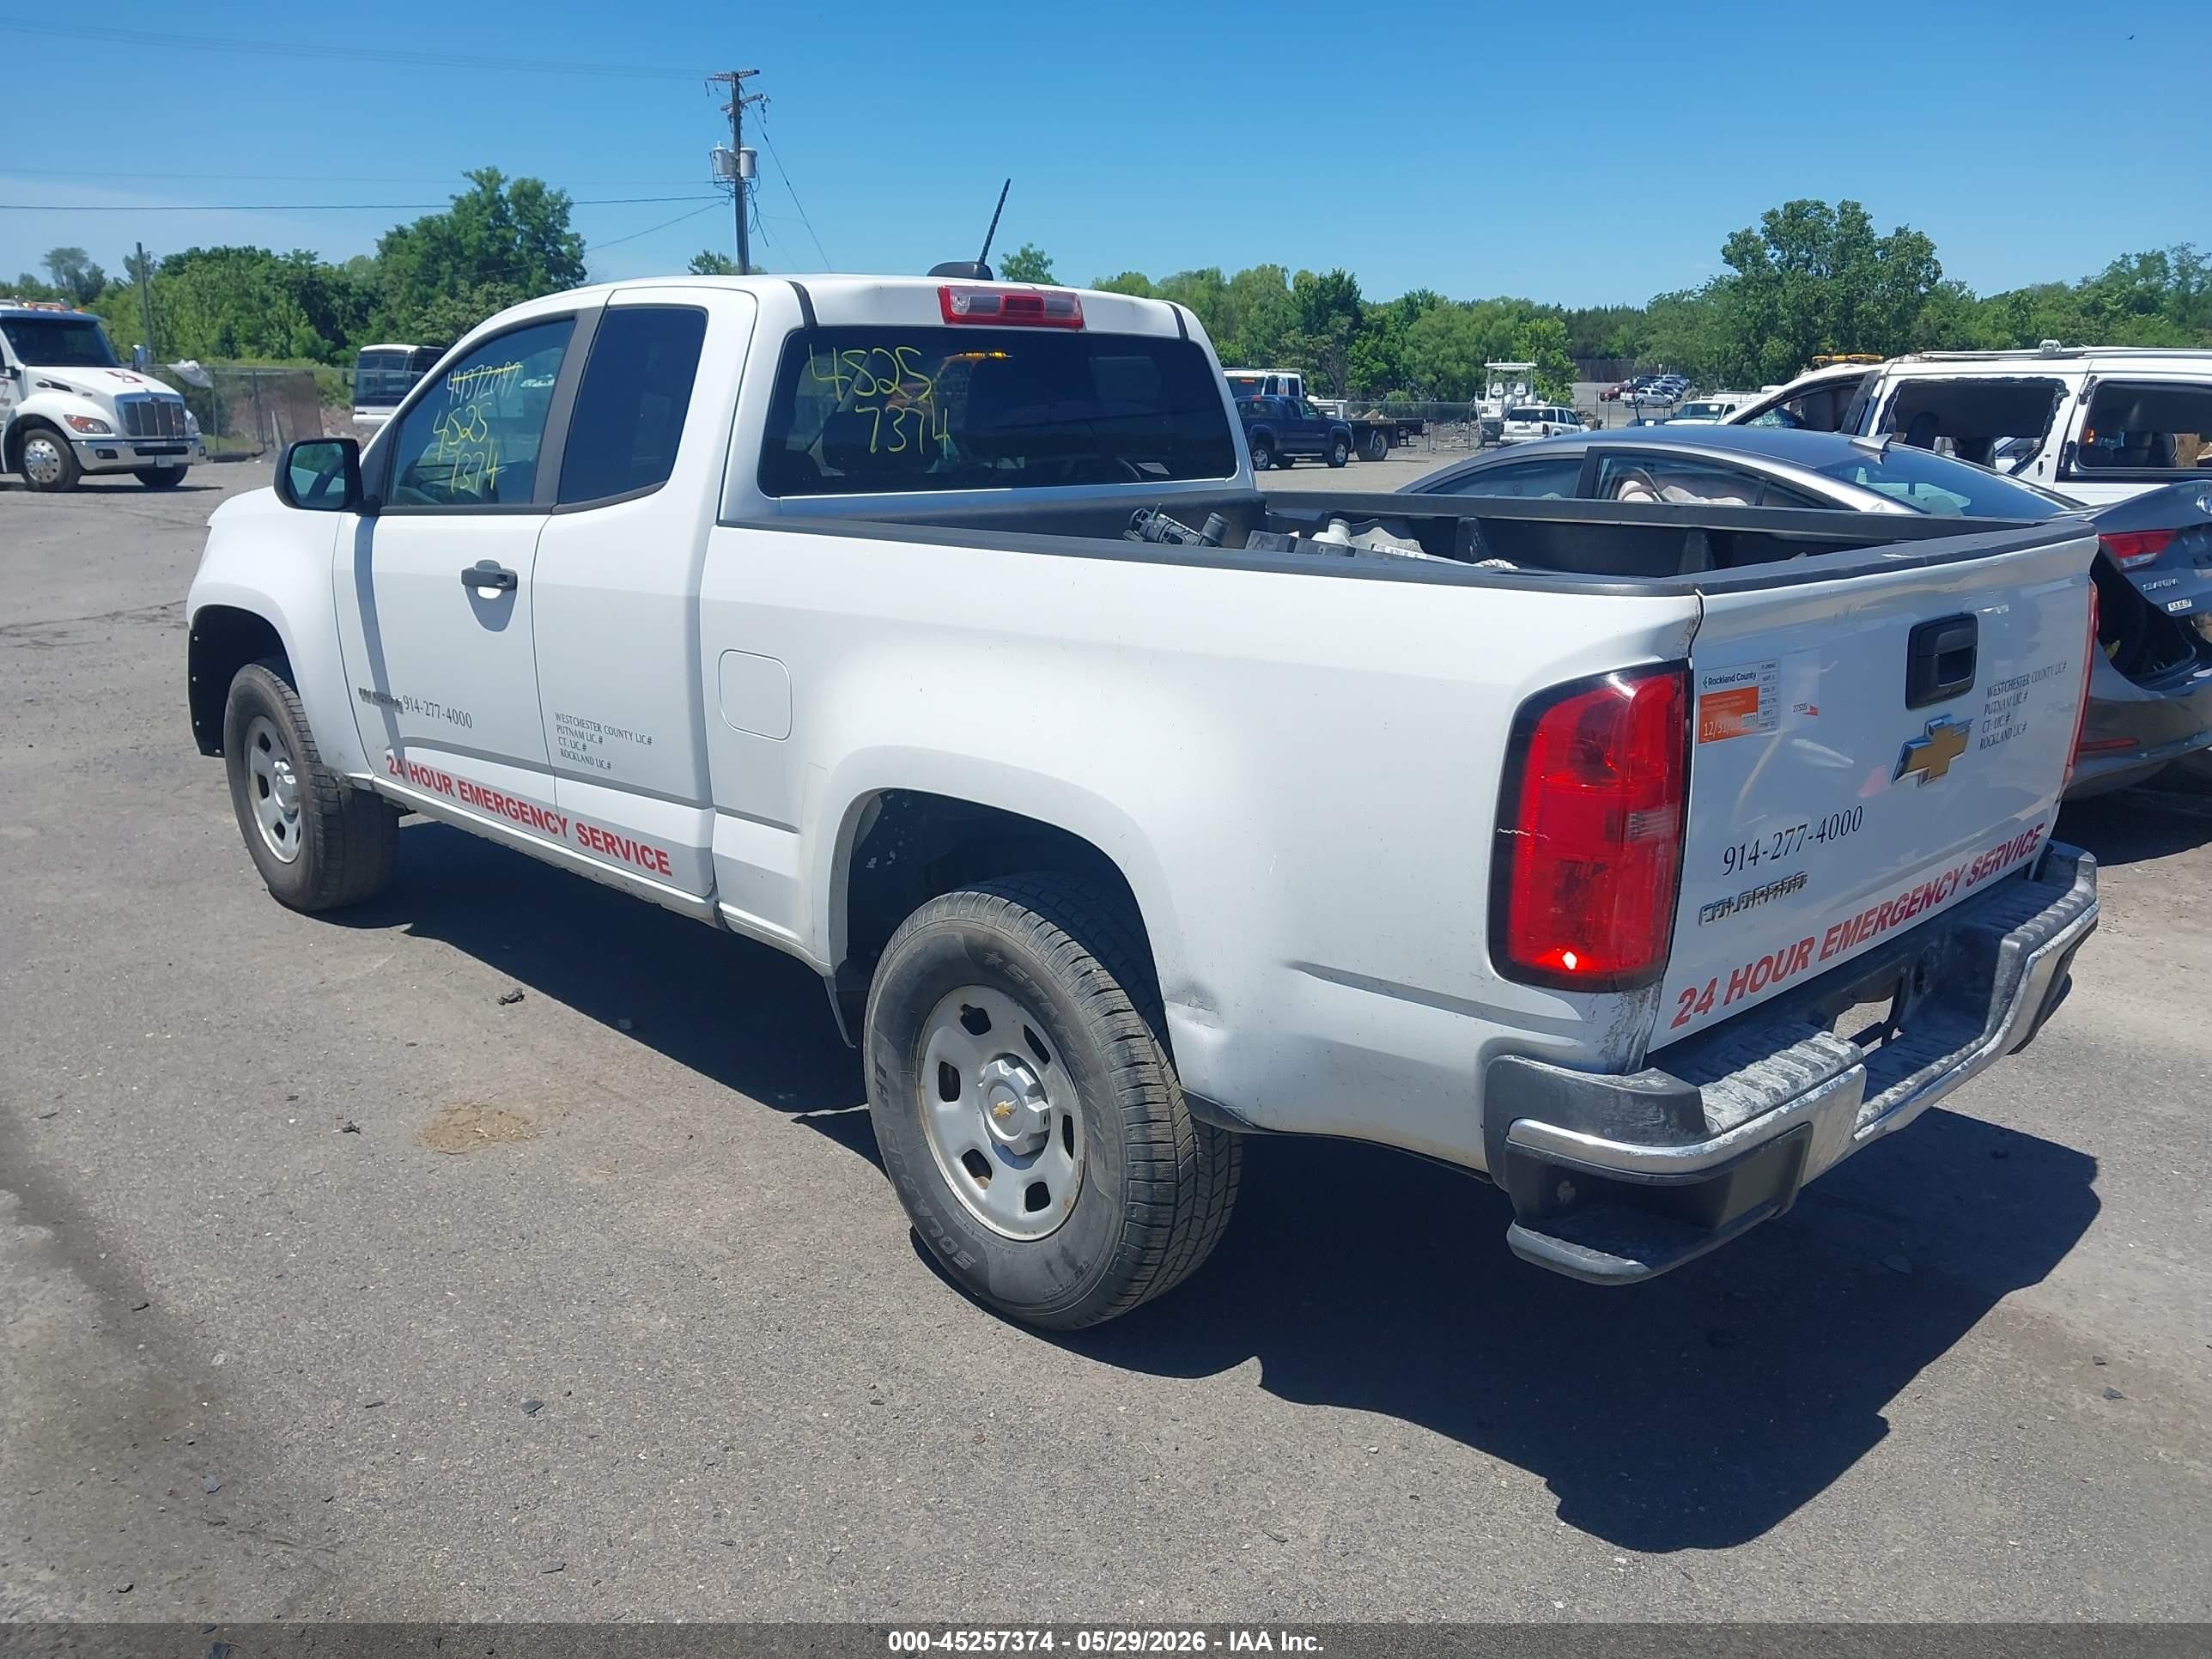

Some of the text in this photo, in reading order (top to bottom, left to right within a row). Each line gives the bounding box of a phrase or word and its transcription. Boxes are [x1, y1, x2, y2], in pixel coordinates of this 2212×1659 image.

[433, 401, 492, 461] 4525
[855, 396, 951, 459] 7374
[1708, 672, 1735, 686] Rockland
[1736, 671, 1757, 682] County
[1986, 673, 2030, 699] WESTCHESTER
[403, 694, 473, 729] 914-277-4000
[555, 712, 602, 733] WESTCHESTER
[604, 725, 634, 742] COUNTY
[556, 724, 585, 741] PUTNAM
[560, 748, 594, 766] ROCKLAND
[386, 755, 673, 877] 24 HOUR EMERGENCY SERVICE
[1723, 805, 1863, 876] 914-277-4000
[1669, 822, 2045, 1030] 24 HOUR EMERGENCY SERVICE
